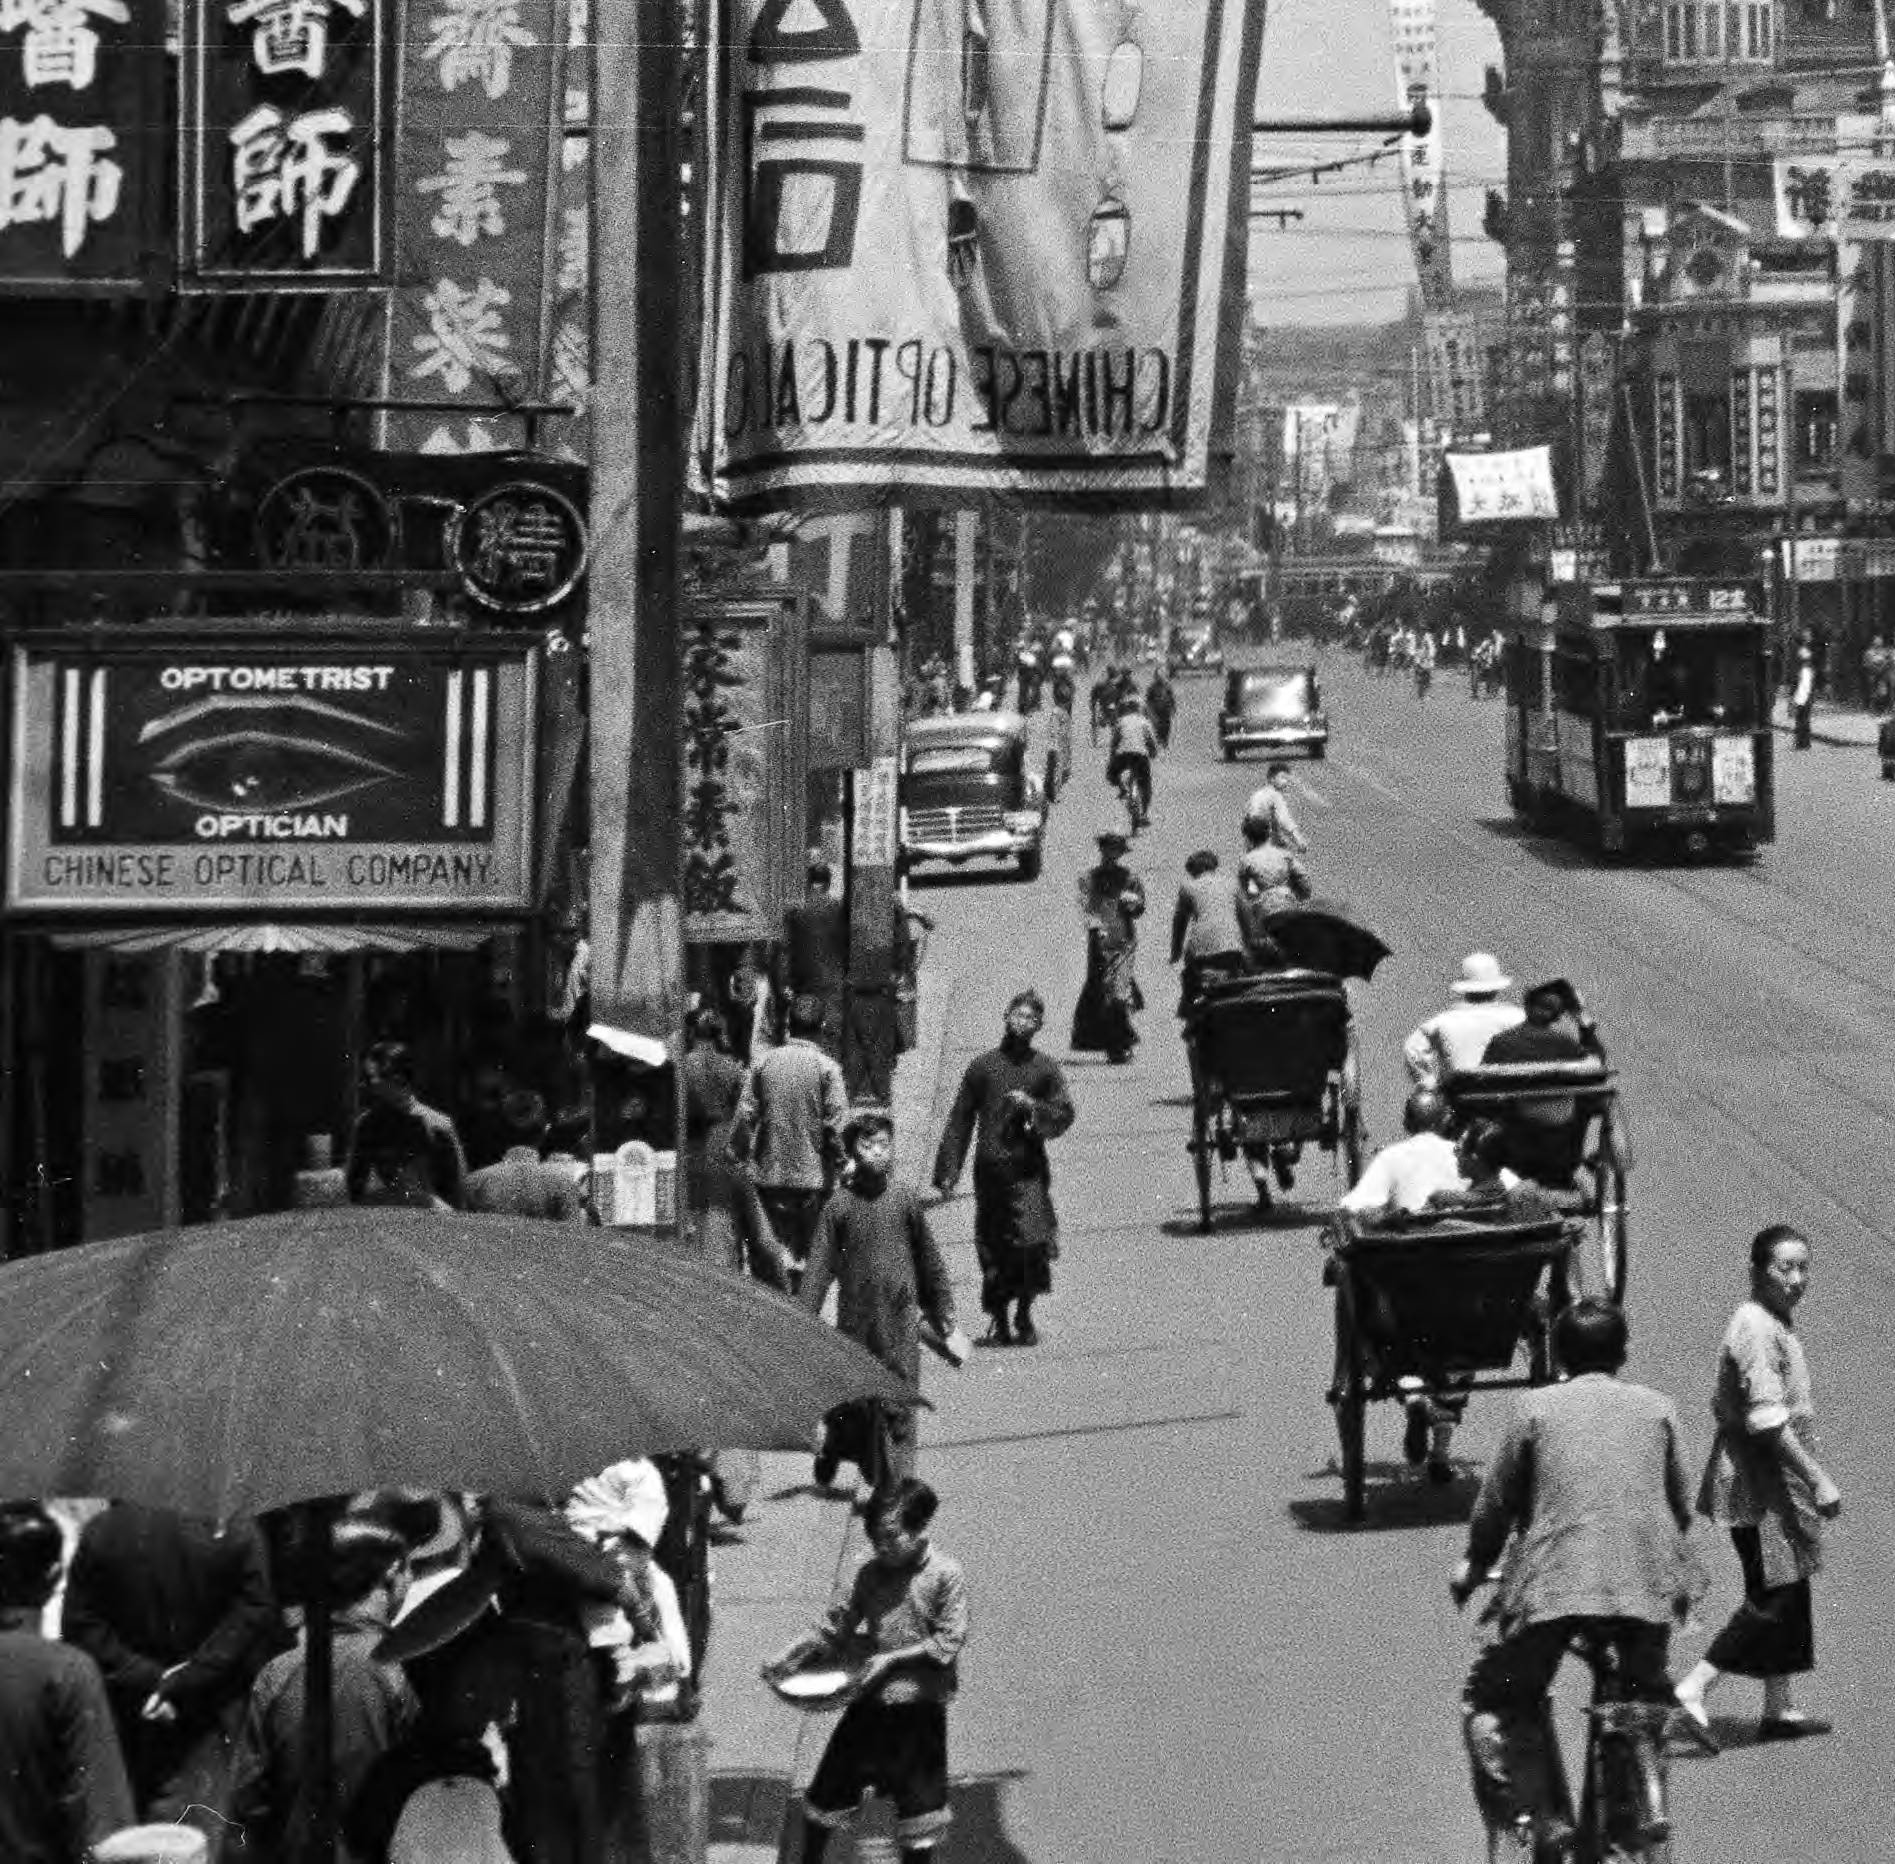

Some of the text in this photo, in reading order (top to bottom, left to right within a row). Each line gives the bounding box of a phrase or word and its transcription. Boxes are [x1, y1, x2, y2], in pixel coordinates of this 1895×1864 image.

[159, 666, 396, 692] OPTOMETRIST
[194, 814, 348, 838] OPTICIAN
[43, 856, 175, 888] CHINESE
[194, 856, 327, 888] OPTICAL
